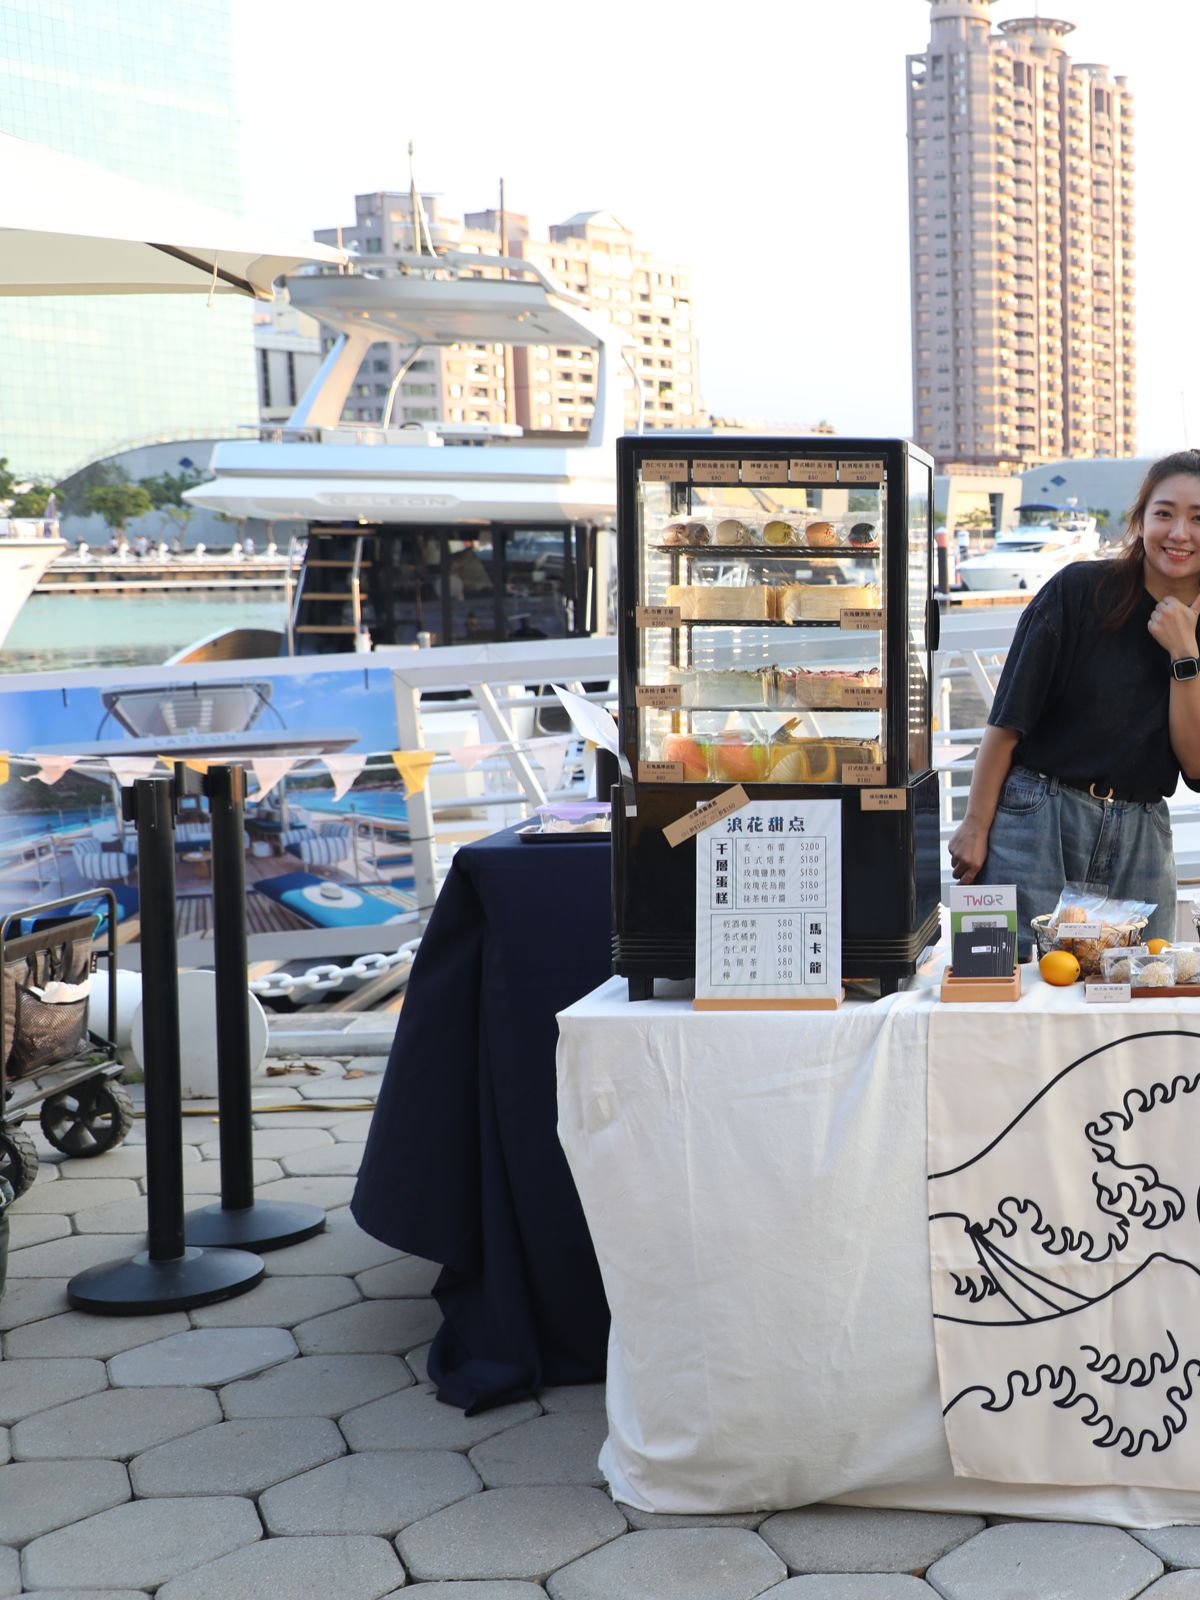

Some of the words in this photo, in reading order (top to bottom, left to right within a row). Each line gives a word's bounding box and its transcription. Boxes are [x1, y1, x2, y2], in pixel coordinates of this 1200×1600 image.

[153, 734, 236, 746] LAGOON
[726, 816, 806, 833] 浪花甜点
[800, 842, 820, 851] $200
[800, 855, 819, 864] $180
[716, 842, 728, 905] 千層蛋糕
[799, 868, 819, 877] $180
[799, 880, 819, 889] $180
[800, 894, 819, 902] $190
[963, 894, 1004, 907] TWQR
[777, 919, 793, 927] $80
[777, 932, 793, 940] $80
[777, 945, 793, 953] $80
[809, 922, 822, 975] 馬卡龍
[777, 957, 793, 966] $80
[777, 970, 793, 979] $80
